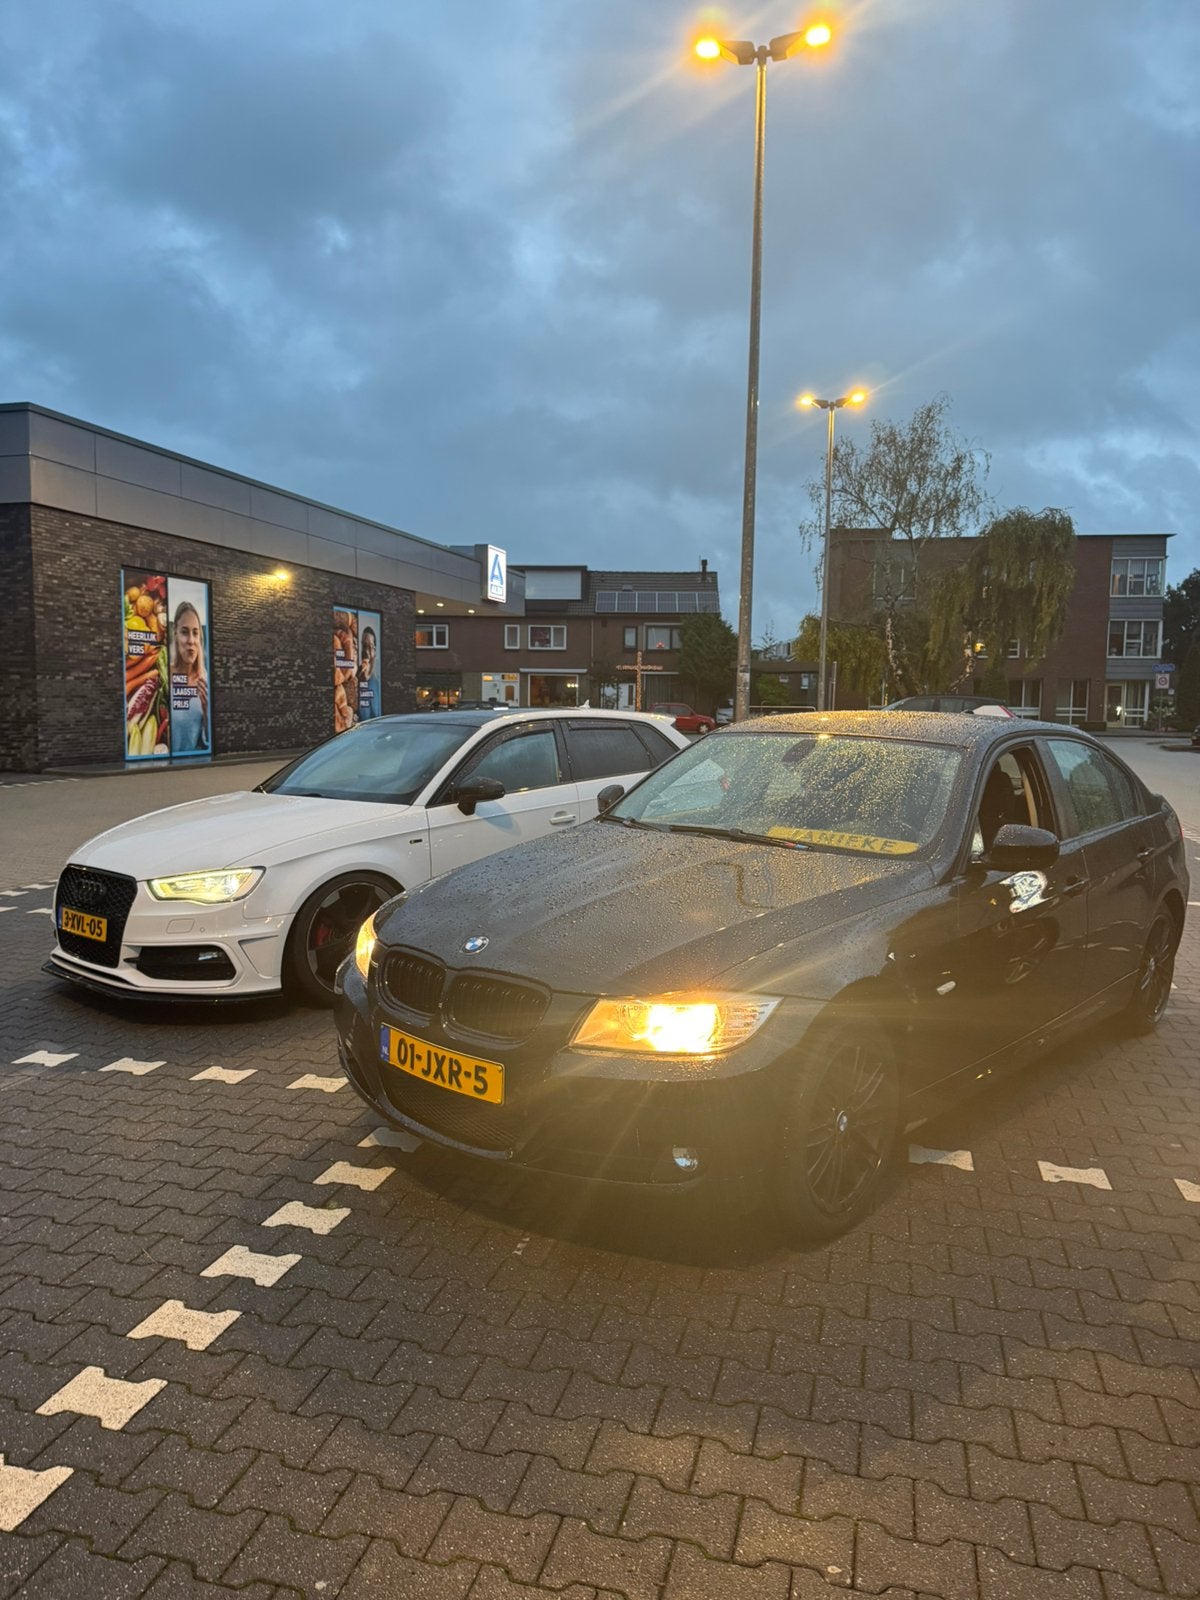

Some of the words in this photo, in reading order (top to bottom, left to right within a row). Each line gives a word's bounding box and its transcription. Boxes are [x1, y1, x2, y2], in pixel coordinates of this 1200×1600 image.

[129, 645, 144, 654] VERS
[173, 675, 188, 683] ONZE
[173, 687, 197, 696] LAAGSTE
[64, 910, 103, 937] 3-XVL-05
[397, 1038, 488, 1095] 01-JXR-5
